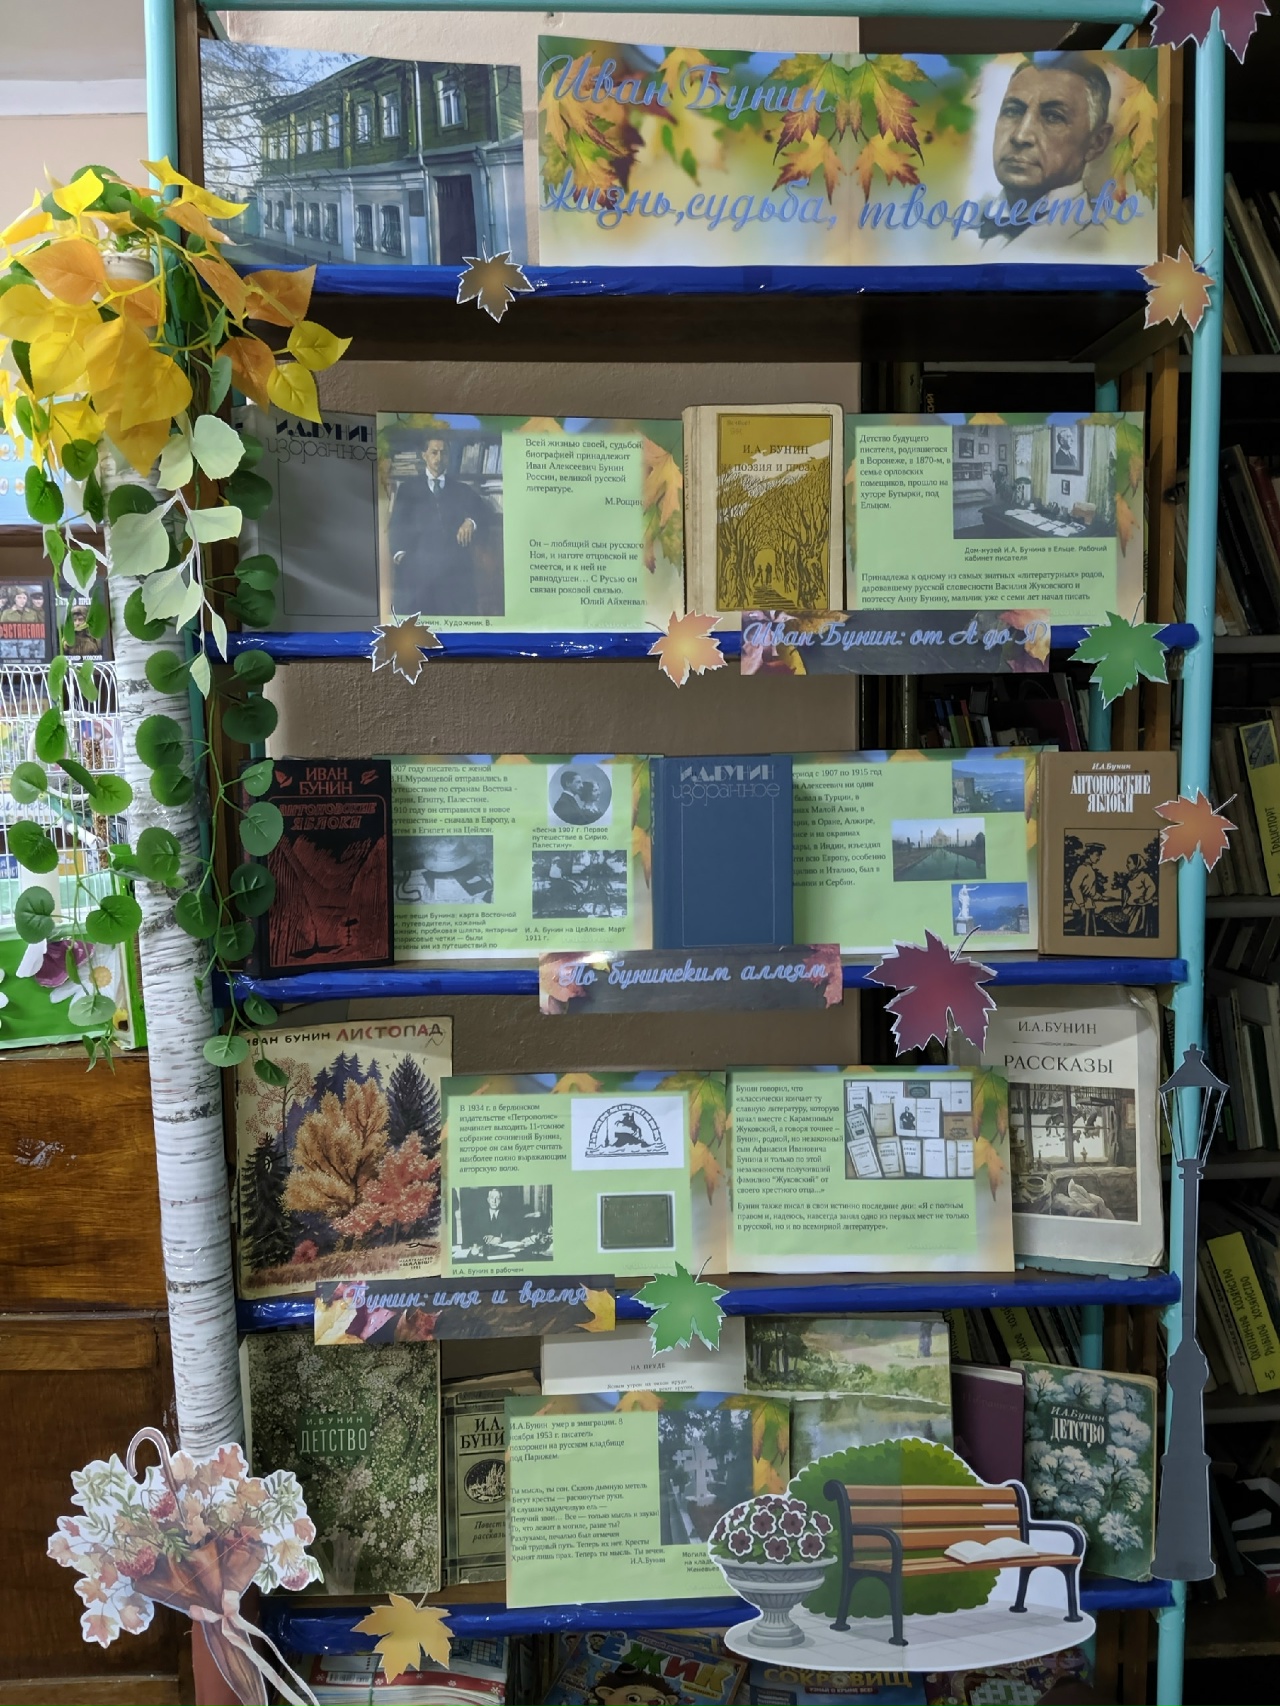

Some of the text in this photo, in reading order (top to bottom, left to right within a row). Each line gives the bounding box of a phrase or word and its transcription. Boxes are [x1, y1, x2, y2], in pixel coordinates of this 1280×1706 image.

[539, 55, 839, 120] Иван Бунин:
[859, 179, 1144, 239] творчество
[525, 450, 574, 460] биографией
[770, 445, 808, 454] БУНИН
[526, 461, 546, 470] Иван
[916, 456, 945, 464] 1870-м,
[734, 464, 772, 472] ПОЭЗИЯ
[786, 464, 816, 472] ПРОЗА
[526, 472, 626, 484] России, великой русской
[526, 485, 572, 494] литературе.
[888, 490, 924, 498] Бутырки,
[605, 497, 644, 507] М.Рощин
[551, 539, 589, 549] любящий
[609, 542, 645, 551] русского
[599, 574, 625, 583] Русью
[558, 586, 590, 594] роковой
[743, 621, 1047, 650] Иван Бунин: от А до Я
[306, 767, 348, 780] ИВАН
[468, 763, 492, 772] женой
[300, 782, 352, 794] БУНИН
[1070, 775, 1150, 794] АНТОНОВСКИЕ
[672, 782, 780, 806] избранное
[1087, 794, 1134, 812] ЯБЛОКИ
[291, 816, 362, 830] ЯБЛОКИ
[559, 958, 828, 990] По бунинским аллеям
[1018, 1021, 1097, 1035] И.А.БУНИН
[247, 1024, 444, 1047] ВАН БУНИН ЛИСТОПАД
[1004, 1054, 1114, 1074] РАССКАЗЫ
[507, 1113, 557, 1121] «Петрополис»
[492, 1290, 508, 1305] и
[518, 1281, 588, 1308] время
[1223, 1268, 1245, 1312] ХОЗЯЙСТВО
[1240, 1276, 1263, 1320] ХОЗЯЙСТВО
[1256, 1324, 1276, 1356] РЫБНОЕ
[306, 1416, 363, 1426] И.БУНИН
[1051, 1406, 1105, 1422] И.А.Бунин
[474, 1415, 504, 1432] И.А.
[509, 1421, 547, 1430] И.А.Бунин
[551, 1422, 569, 1430] умер
[1050, 1417, 1105, 1444] ДЕТСТВО
[300, 1428, 368, 1454] ДЕТСТВО
[601, 1636, 730, 1692] ЕЖИК
